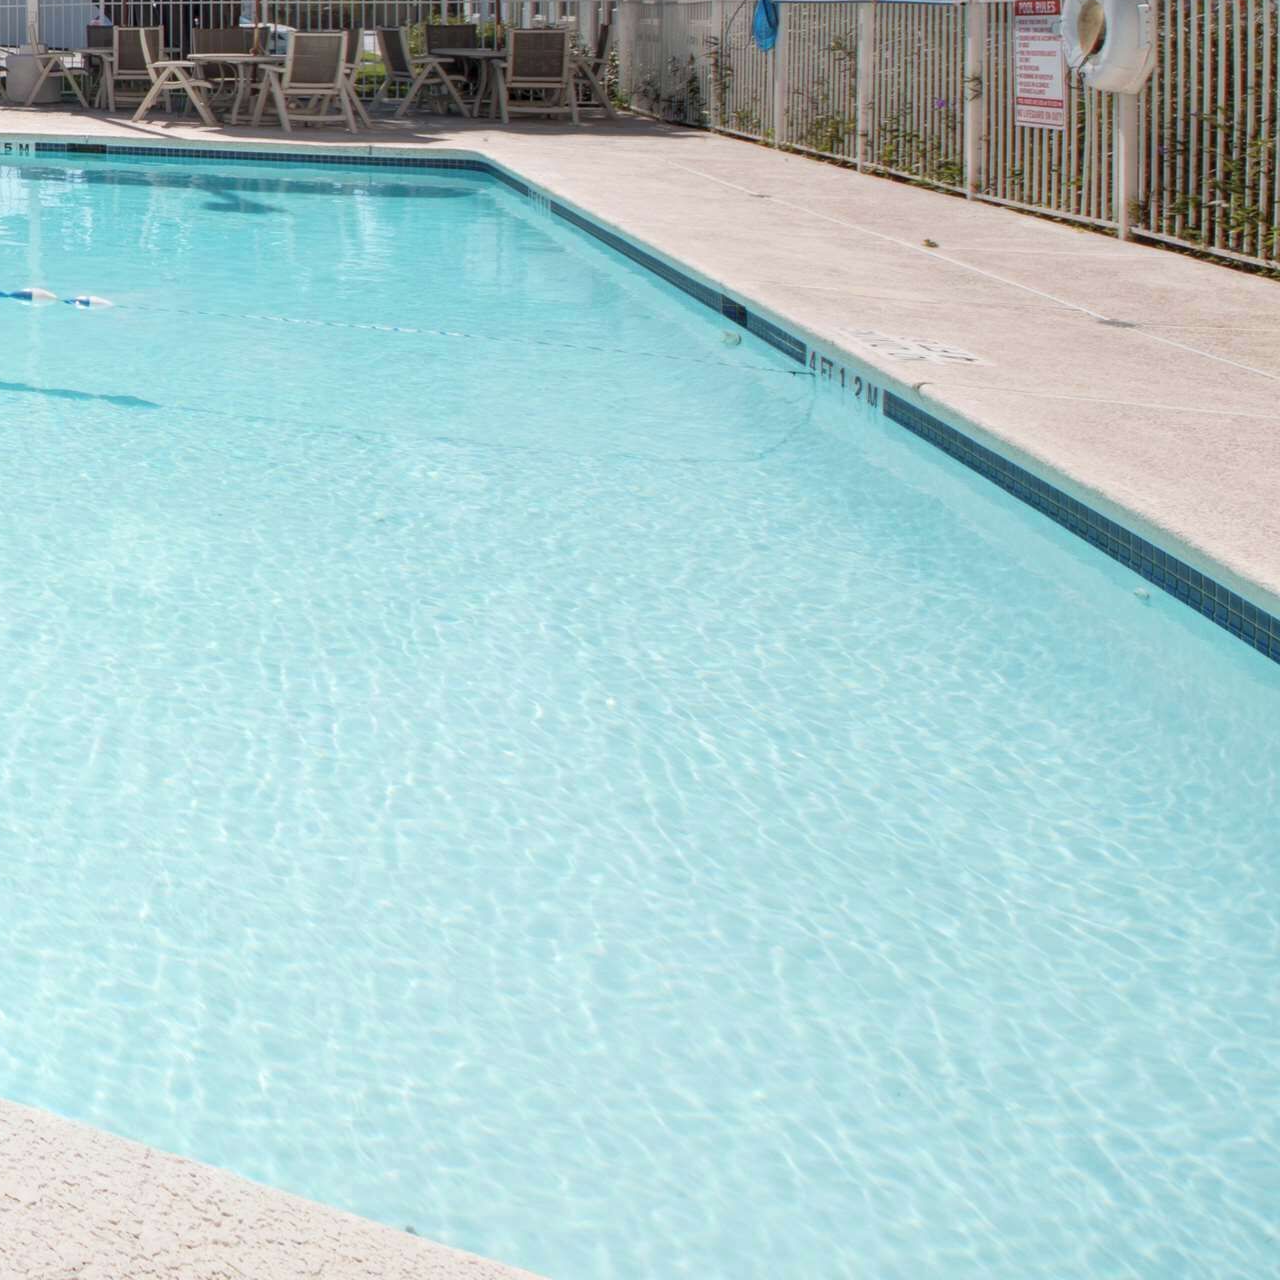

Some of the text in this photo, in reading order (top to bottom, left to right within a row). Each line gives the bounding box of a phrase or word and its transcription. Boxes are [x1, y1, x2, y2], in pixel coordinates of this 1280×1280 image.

[1018, 0, 1057, 14] POOL RULES
[809, 351, 816, 371] 4
[821, 356, 834, 380] FT
[867, 383, 878, 408] M
